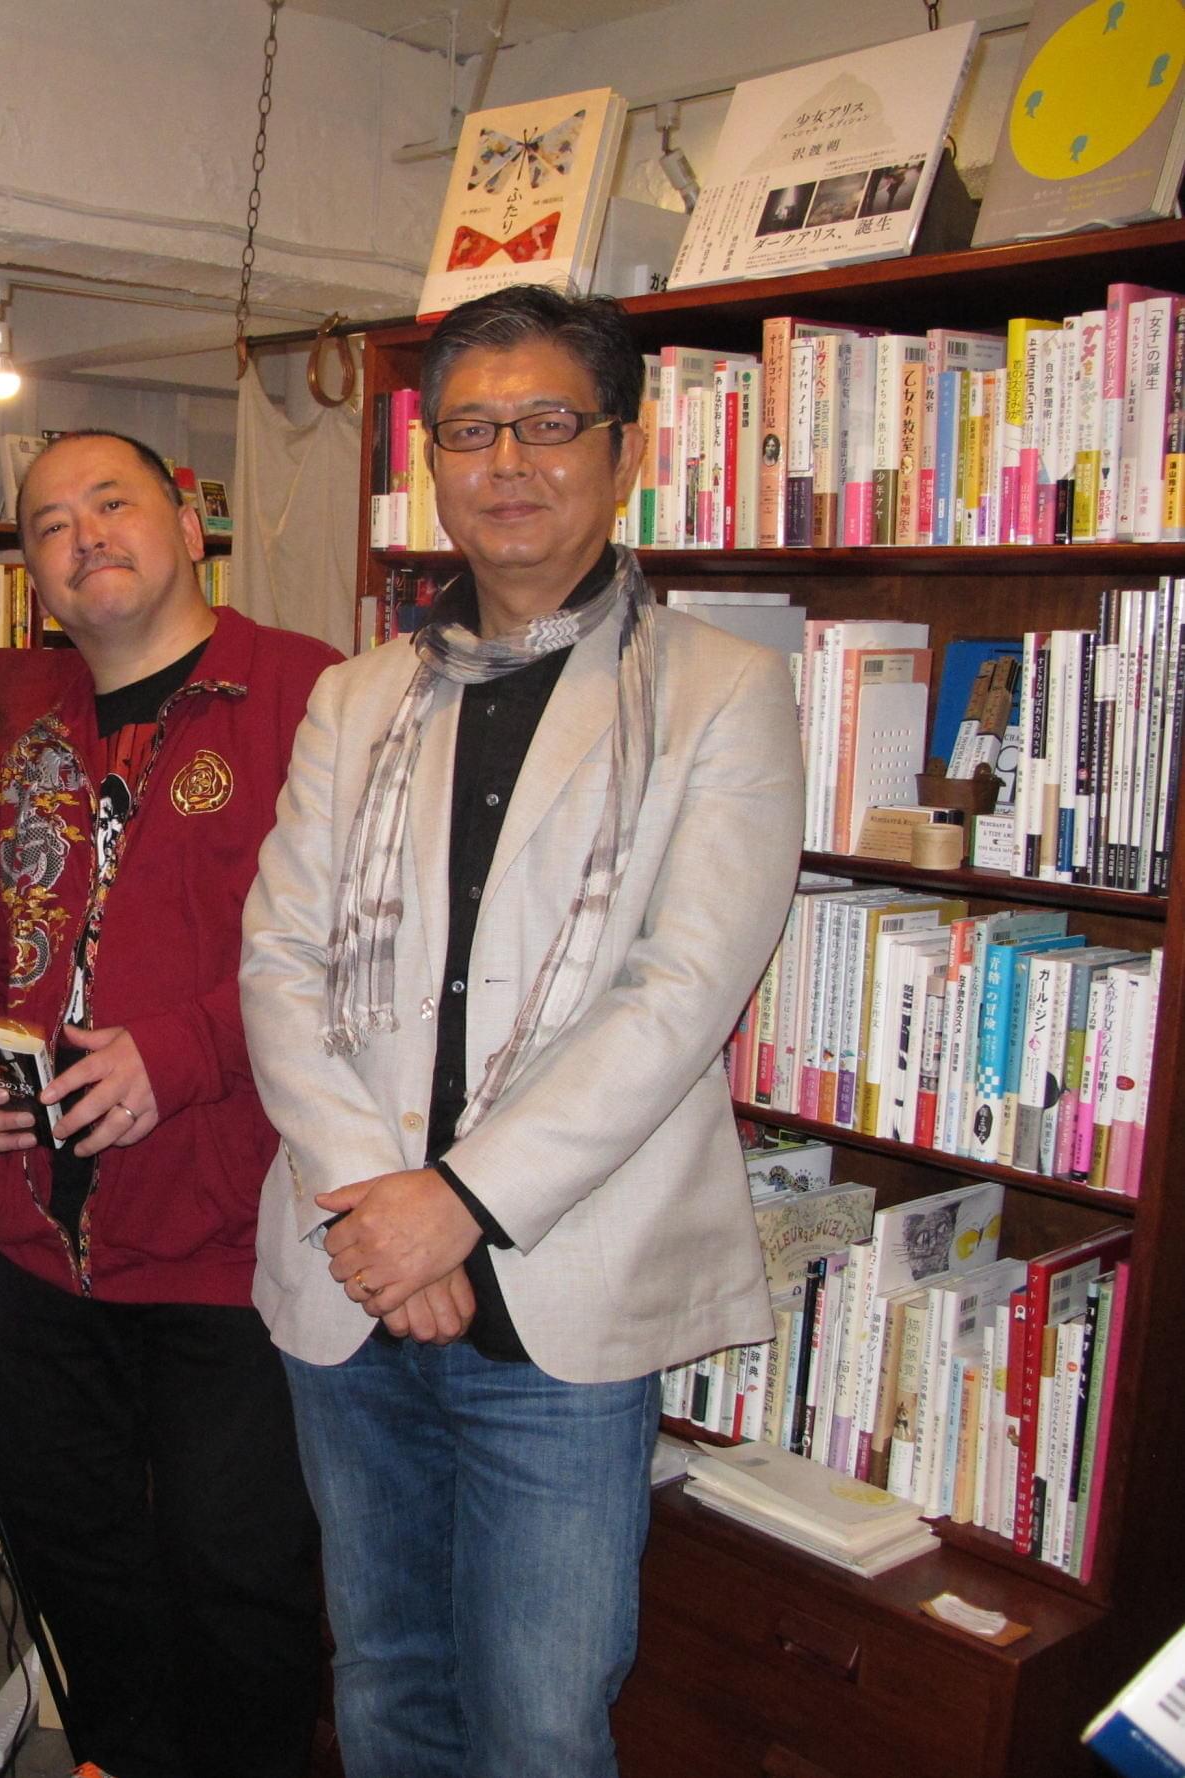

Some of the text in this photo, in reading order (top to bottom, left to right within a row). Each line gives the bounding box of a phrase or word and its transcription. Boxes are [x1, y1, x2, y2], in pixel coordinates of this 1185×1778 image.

[796, 101, 864, 126] 少女アリス
[502, 187, 523, 235] ふたり
[765, 334, 777, 429] オールコットの日記
[1145, 307, 1164, 391] 「女子」の誕生
[714, 375, 723, 448] あしながおじさん
[901, 368, 917, 452] 乙女の教室
[874, 472, 886, 521] 少年アヤ
[1034, 968, 1050, 1033] ガール・ジン
[748, 1347, 761, 1378] 辞典
